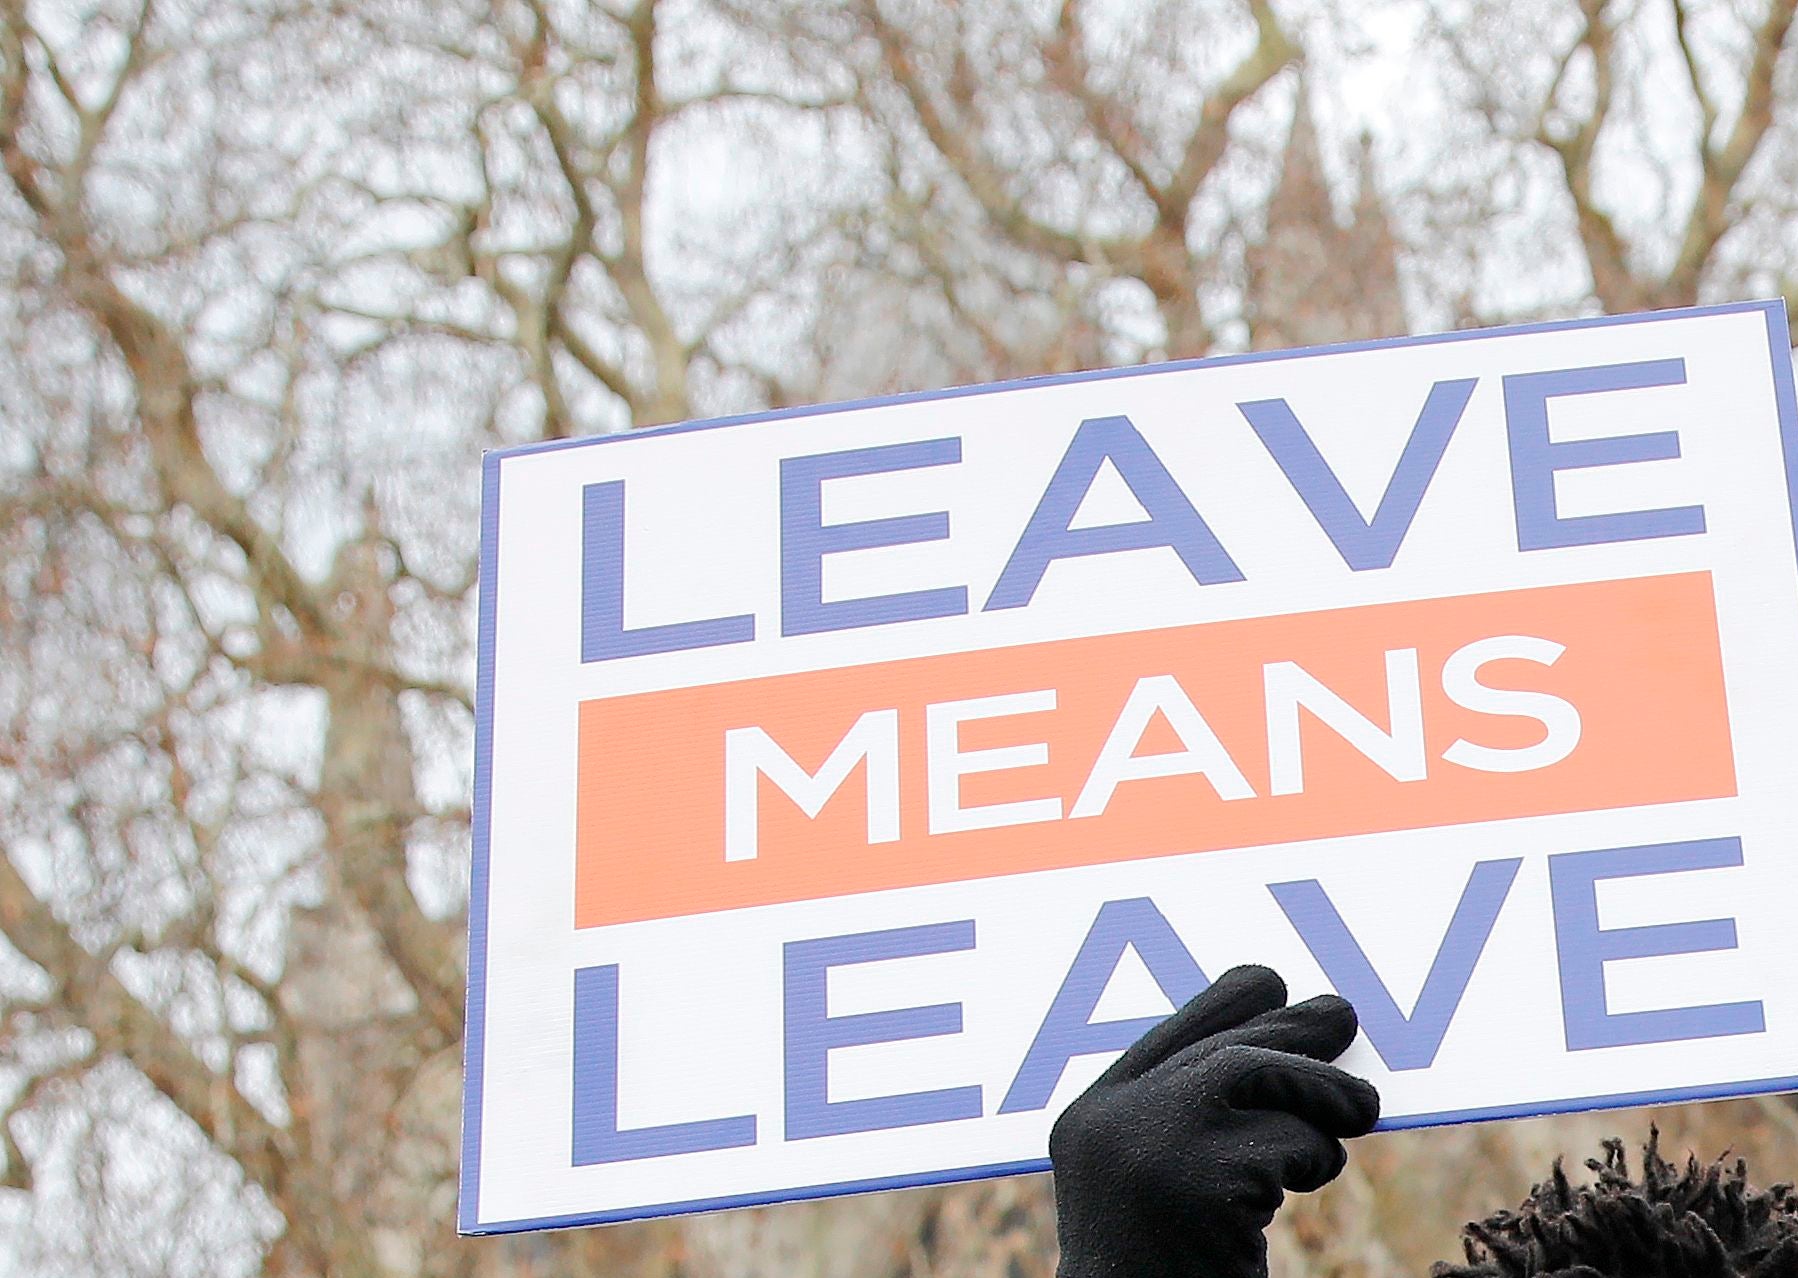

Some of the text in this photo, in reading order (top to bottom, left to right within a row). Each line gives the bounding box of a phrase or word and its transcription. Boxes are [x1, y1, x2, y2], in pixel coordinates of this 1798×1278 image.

[581, 356, 1706, 665] LEAVE
[726, 636, 1580, 861] MEANS
[572, 837, 1766, 1167] LEAVE
